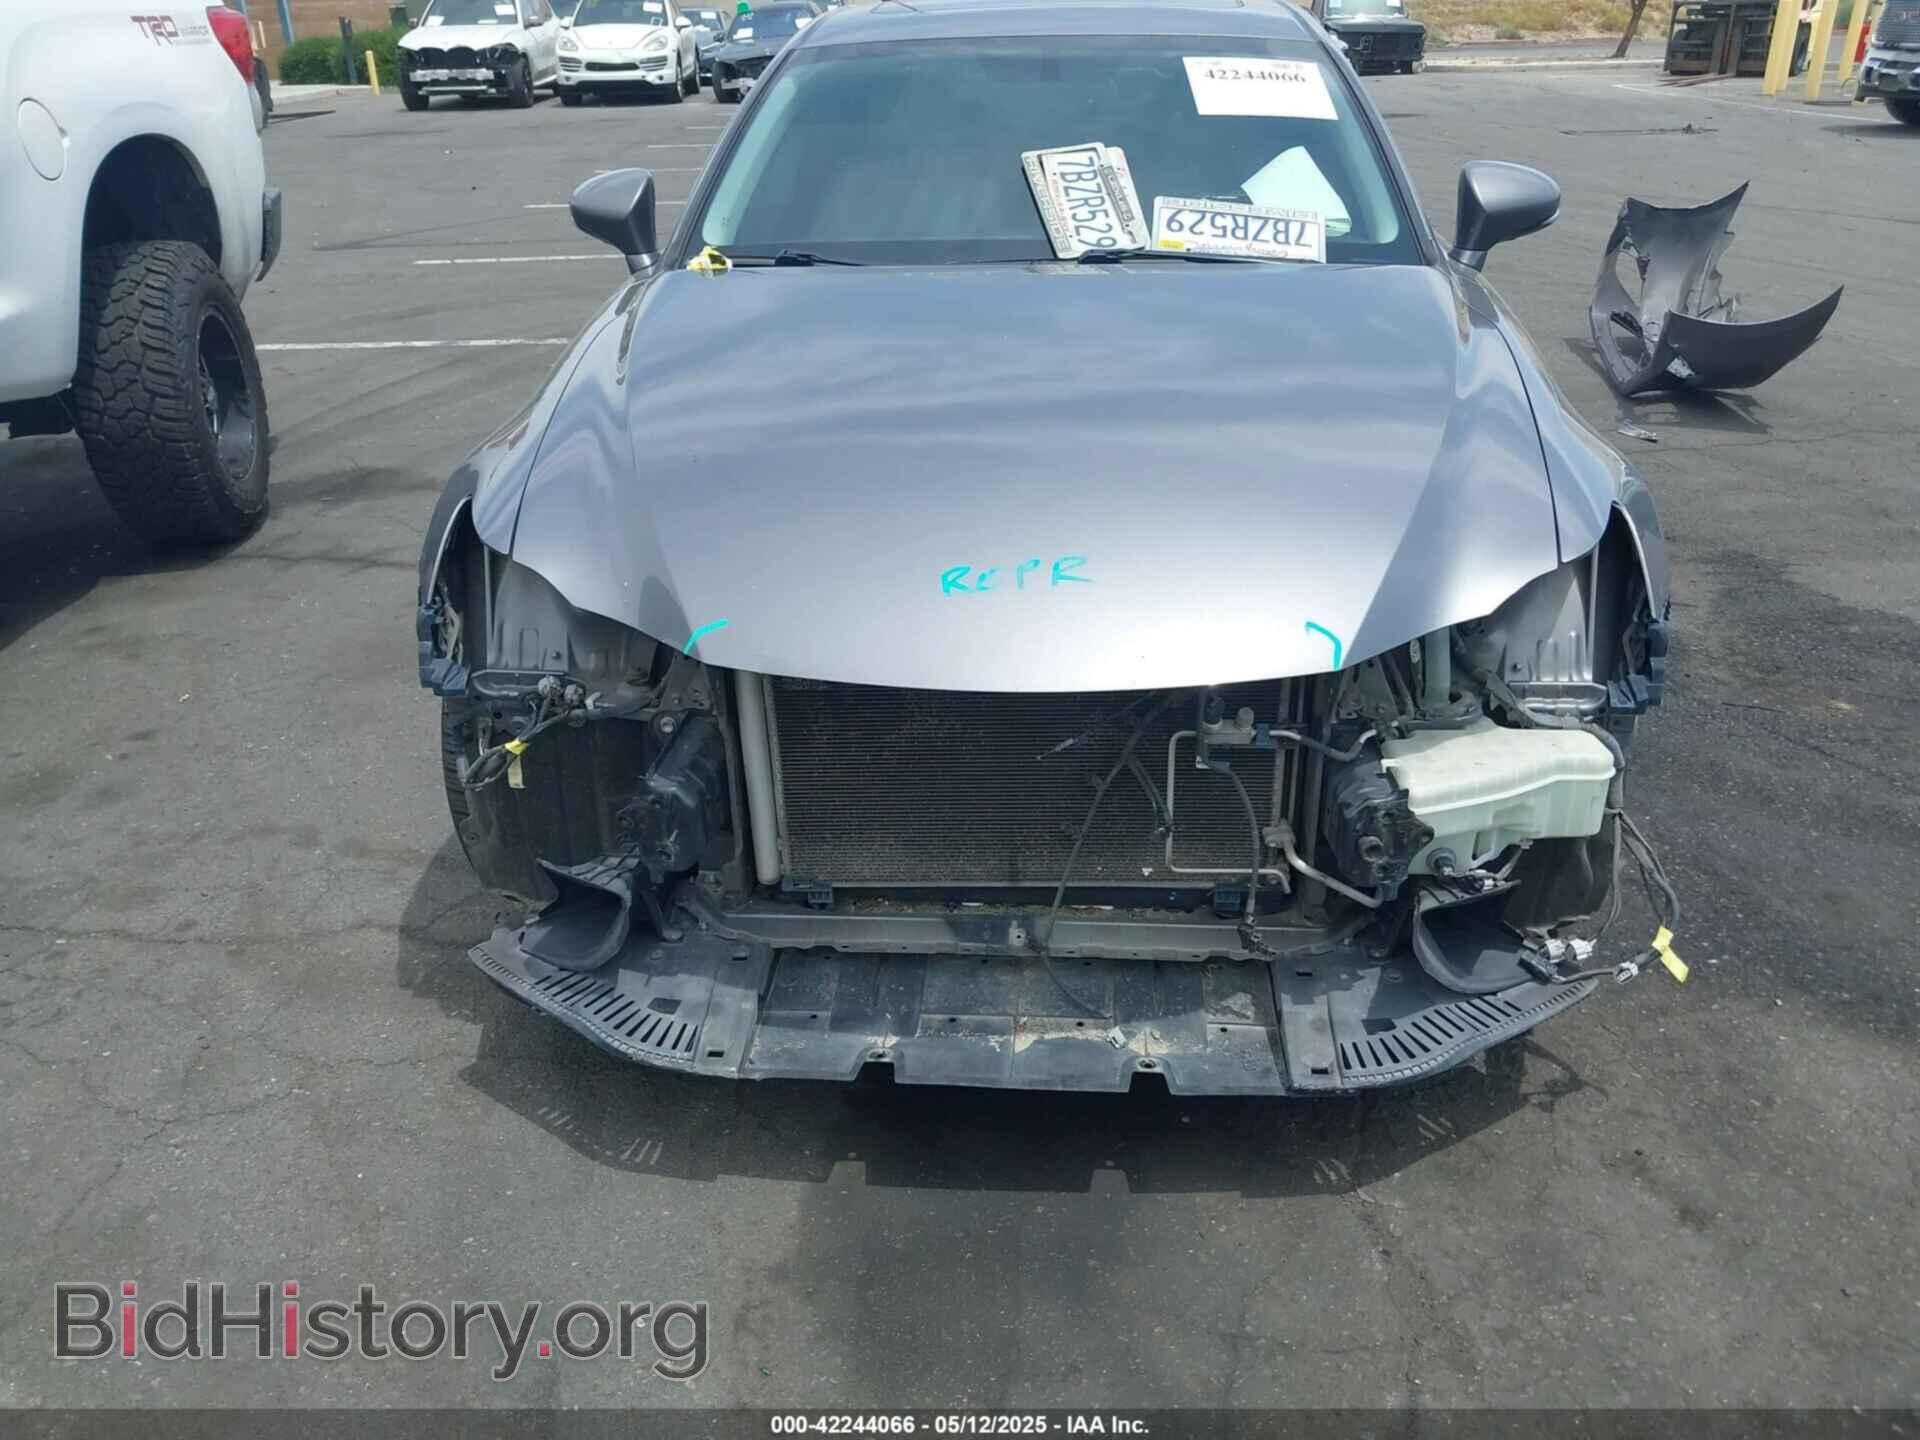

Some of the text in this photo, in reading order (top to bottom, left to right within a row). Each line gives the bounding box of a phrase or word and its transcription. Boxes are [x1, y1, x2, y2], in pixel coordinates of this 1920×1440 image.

[130, 15, 178, 46] TRD
[1204, 68, 1307, 83] 42244066
[1057, 156, 1117, 248] 7BZR529
[1166, 208, 1313, 248] 7BZR529
